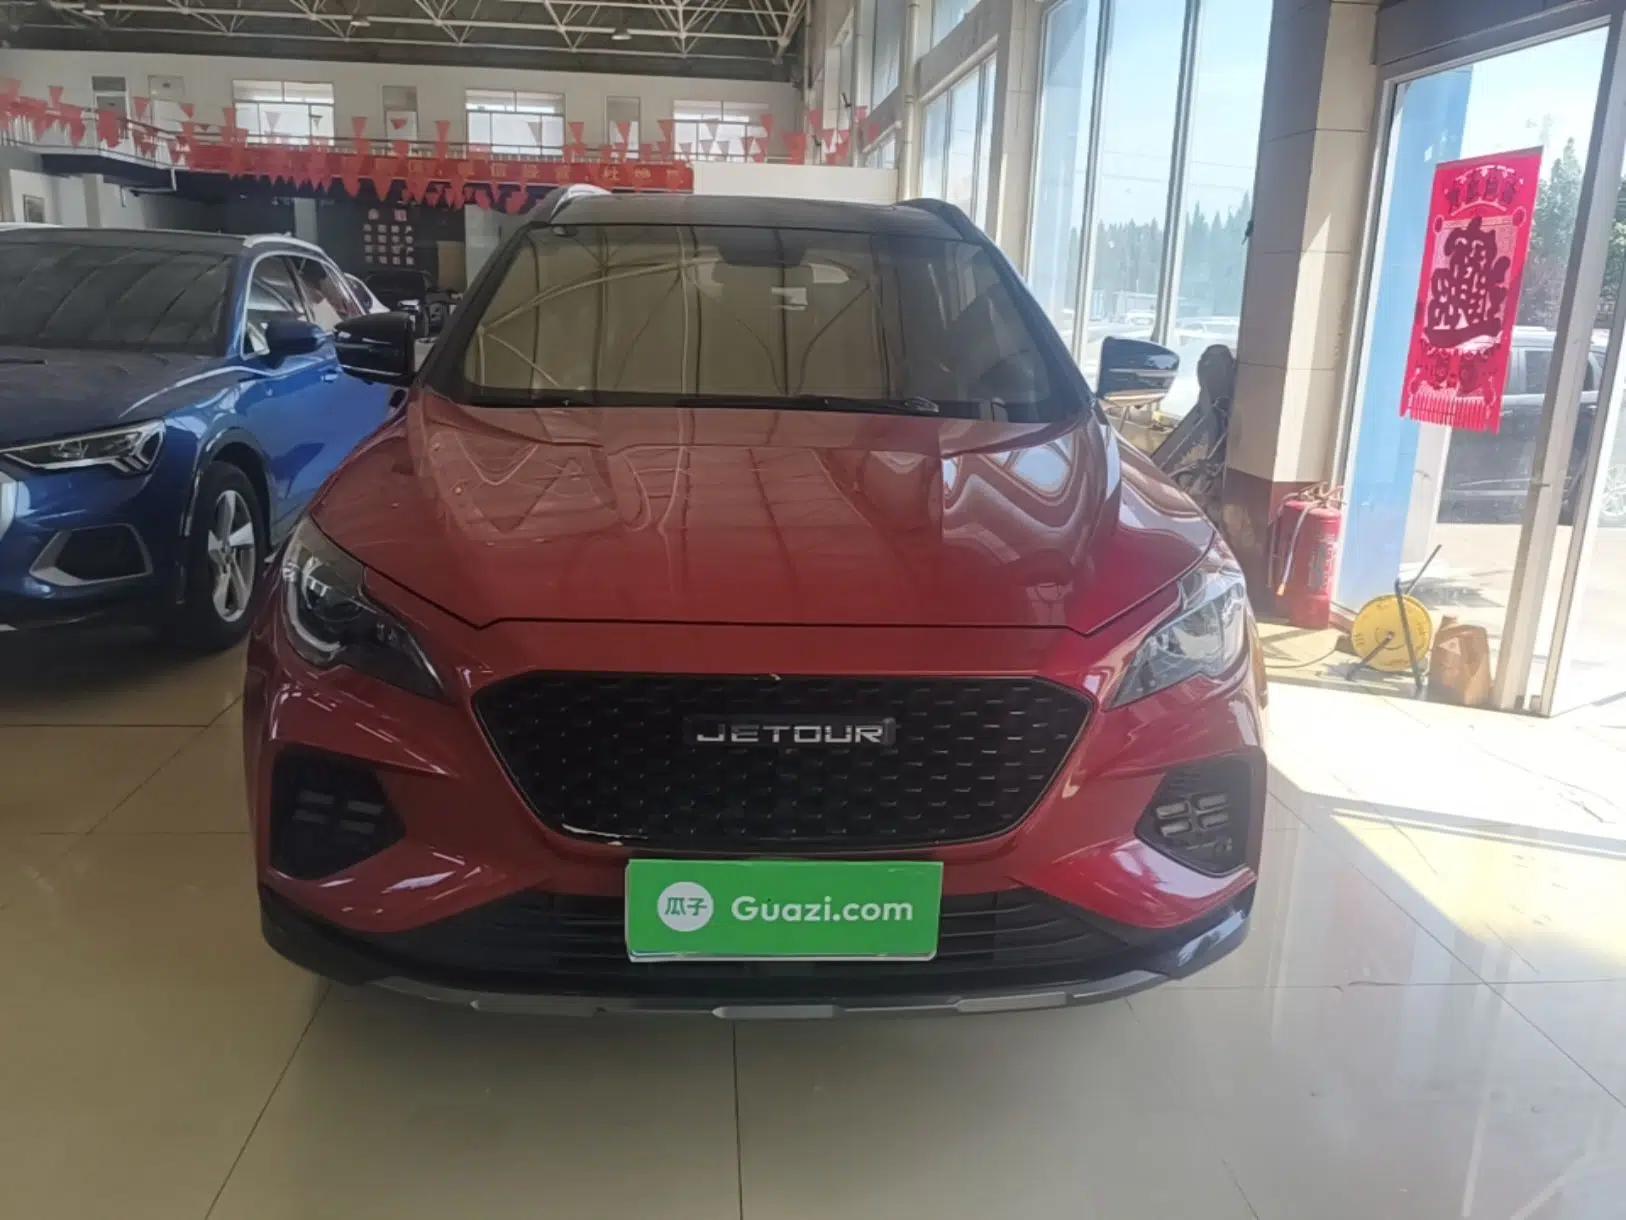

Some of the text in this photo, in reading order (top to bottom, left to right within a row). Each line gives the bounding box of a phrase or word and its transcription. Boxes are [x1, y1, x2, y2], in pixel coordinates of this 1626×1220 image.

[697, 724, 883, 743] JETOUR
[665, 896, 707, 916] 瓜子
[731, 896, 913, 921] Guazi.com
